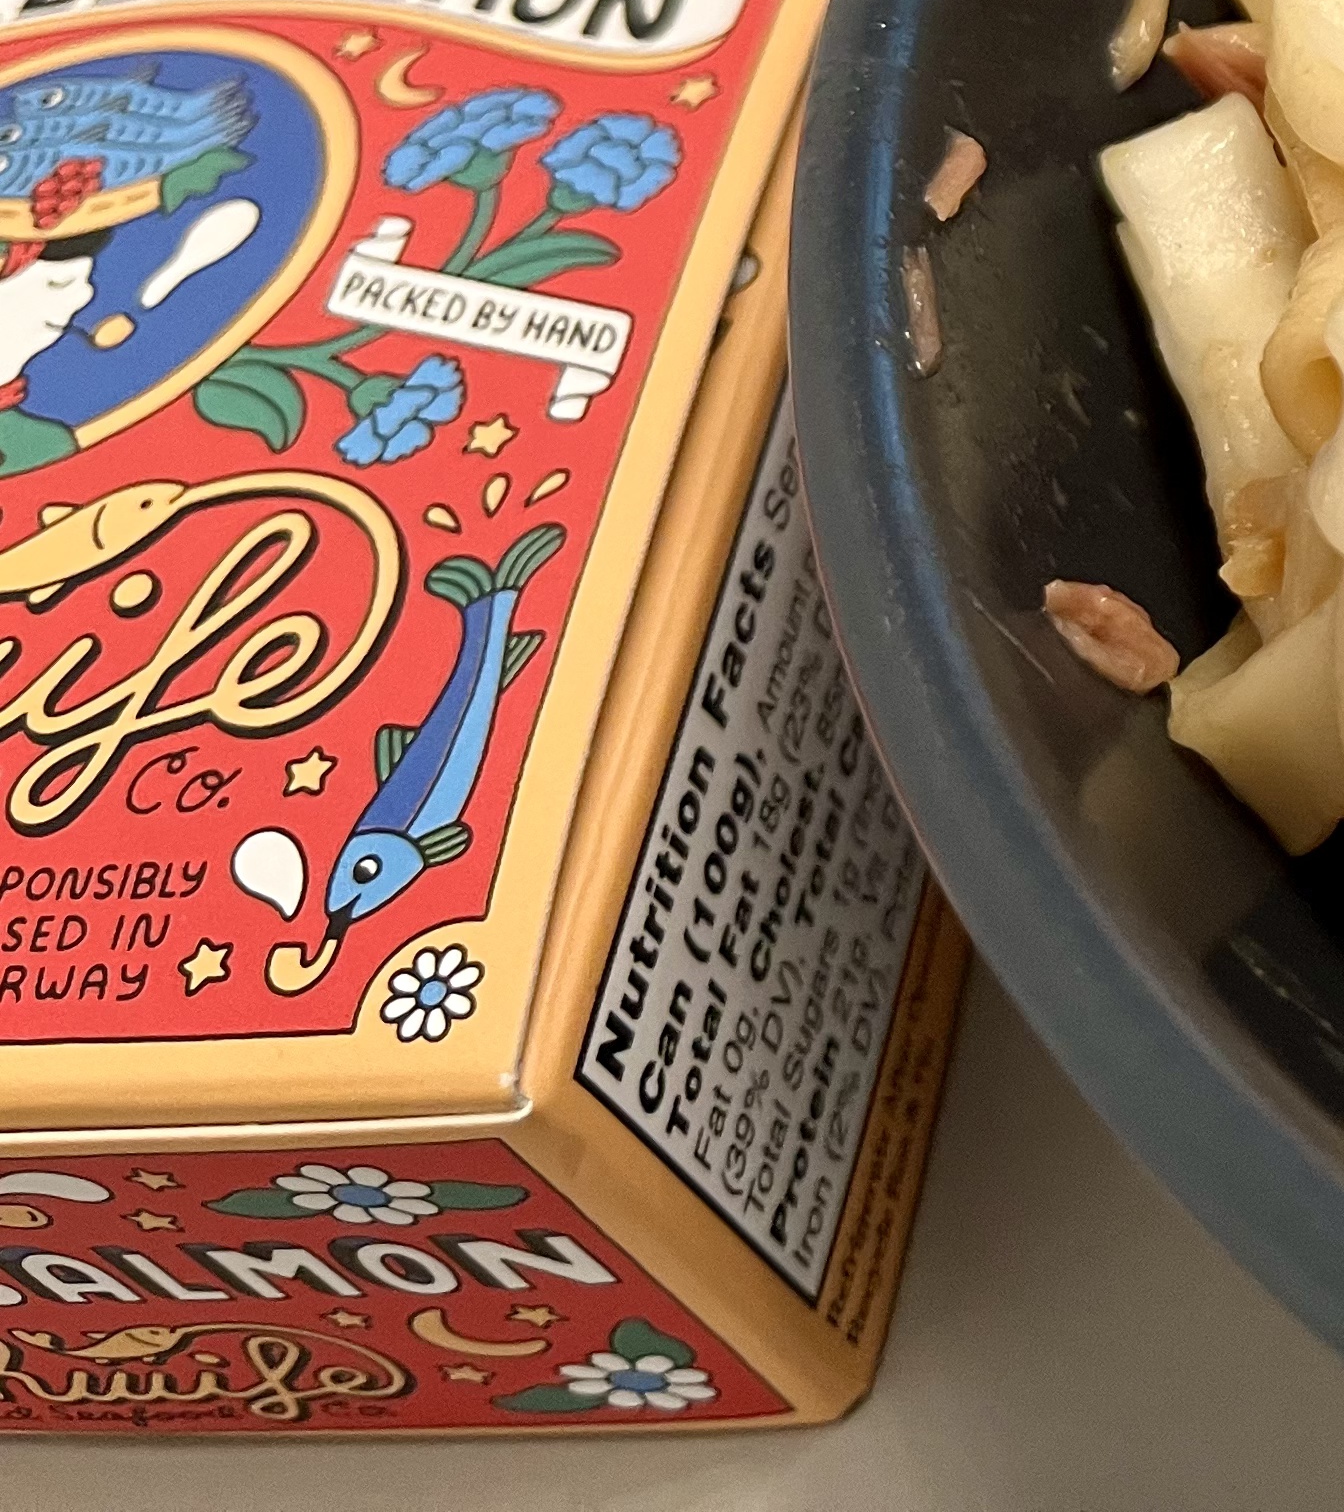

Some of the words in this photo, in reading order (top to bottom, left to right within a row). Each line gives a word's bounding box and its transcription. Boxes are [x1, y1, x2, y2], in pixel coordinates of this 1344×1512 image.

[340, 272, 467, 324] PACKED
[472, 299, 518, 334] BY
[523, 308, 618, 354] HAND
[126, 746, 243, 815] Co.
[595, 742, 717, 1084] Nutrition
[700, 535, 777, 730] Facts
[763, 434, 798, 531] Ser
[0, 861, 208, 901] PONSIBLY
[1, 914, 88, 952] SED
[110, 913, 171, 951] IN
[665, 977, 728, 1135] Total
[718, 865, 761, 970] Fat
[753, 771, 794, 850] 18g
[0, 963, 149, 1003] RWAY
[722, 1069, 770, 1193] (39%
[794, 785, 845, 924] Total
[638, 980, 694, 1114] Can
[692, 1079, 733, 1171] Fat
[743, 1097, 793, 1212] Total
[768, 1034, 841, 1246] Protein
[791, 1170, 833, 1270] Iron
[0, 1234, 617, 1307] ALMON
